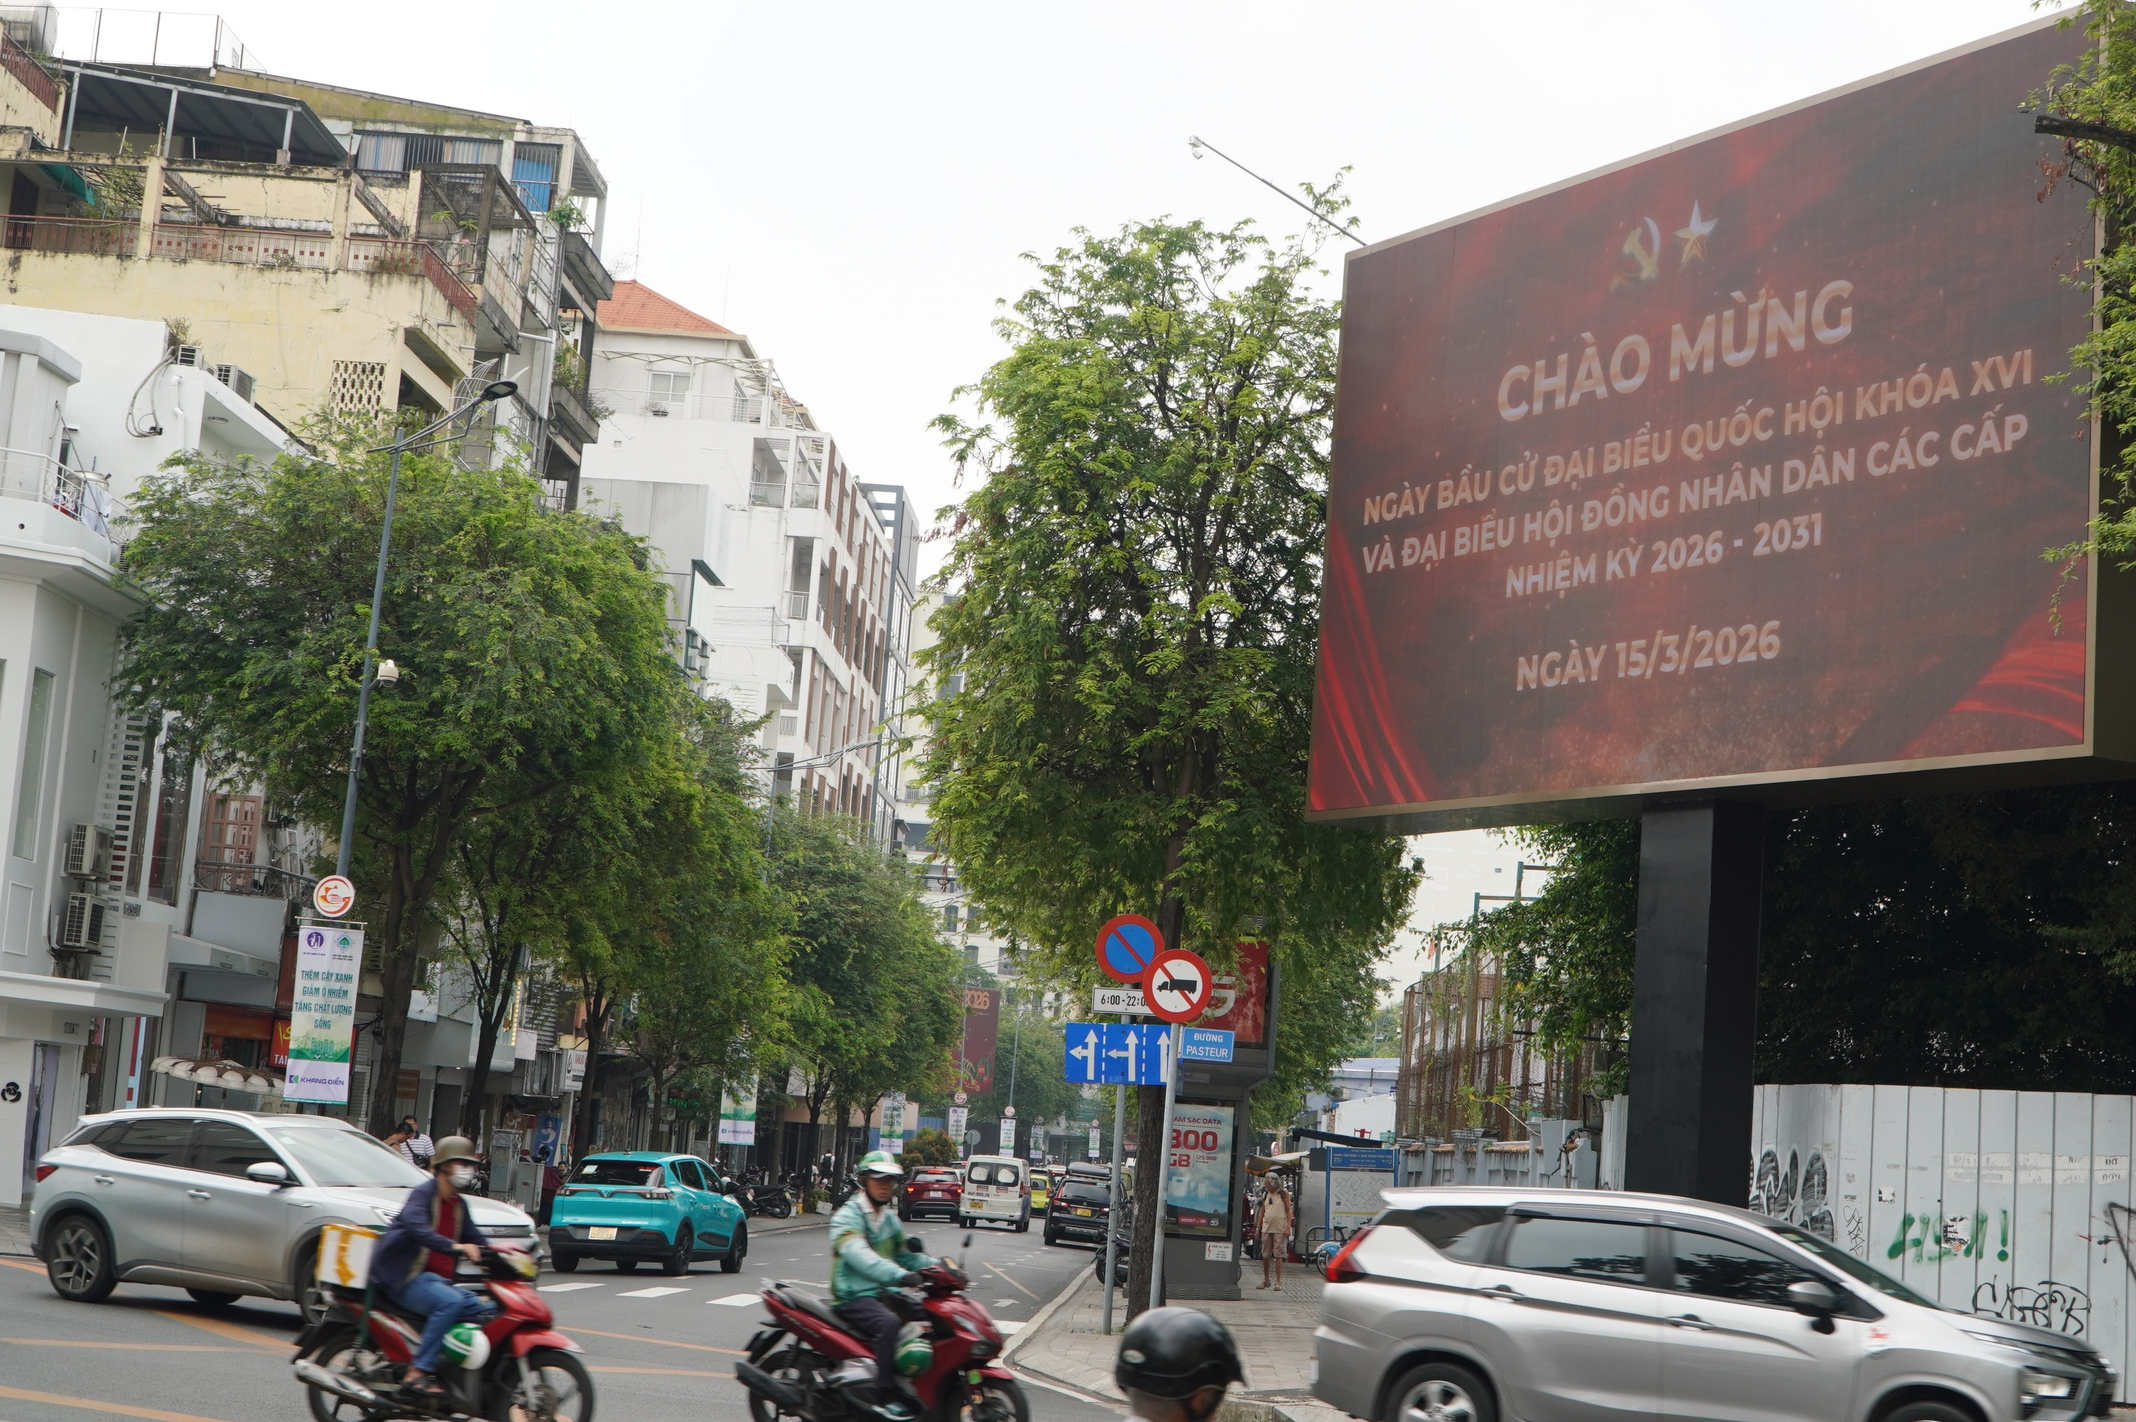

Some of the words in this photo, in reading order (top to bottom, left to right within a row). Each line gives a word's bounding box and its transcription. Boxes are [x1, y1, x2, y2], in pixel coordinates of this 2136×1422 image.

[1498, 331, 1651, 422] CHÀO
[1669, 279, 1854, 382] MỪNG
[1363, 482, 1431, 525] NGÀY
[1437, 464, 1491, 509] BẦU
[1499, 451, 1538, 495] CỬ
[1544, 447, 1594, 490] ĐẠI
[1603, 421, 1672, 474] BIỂU
[1681, 399, 1775, 461] QUỐC
[1784, 386, 1844, 439] HỘI
[1855, 362, 1960, 420] KHÓA
[1969, 349, 2032, 396] XVI
[1362, 534, 1395, 574] VÀ
[1401, 530, 1446, 571] ĐẠI
[1454, 508, 1514, 557] BIỂU
[1523, 499, 1573, 547] HỘI
[1581, 482, 1669, 532] ĐỒNG
[1679, 461, 1772, 513] NHÂN
[1782, 445, 1855, 494] DÂN
[1866, 427, 1940, 477] CÁC
[1950, 404, 2029, 461] CẤP
[1506, 550, 1597, 598] NHIỆM
[1605, 537, 1644, 581] KỲ
[1650, 530, 1724, 573] 2026
[1753, 512, 1823, 556] 2031
[1516, 639, 1607, 691] NGÀY
[1616, 620, 1781, 679] 15/3/2026
[301, 969, 320, 980] THÊM
[321, 970, 334, 982] CÂY
[334, 972, 353, 983] XANH
[302, 984, 320, 996] GIẢM
[1101, 994, 1147, 1007] 6:00-22:0
[331, 1004, 352, 1017] LƯỢNG
[314, 1017, 331, 1029] SỐNG
[1194, 1032, 1223, 1043] ĐƯỜNG
[1186, 1045, 1228, 1058] PASTEUR
[300, 1077, 326, 1085] KHANG
